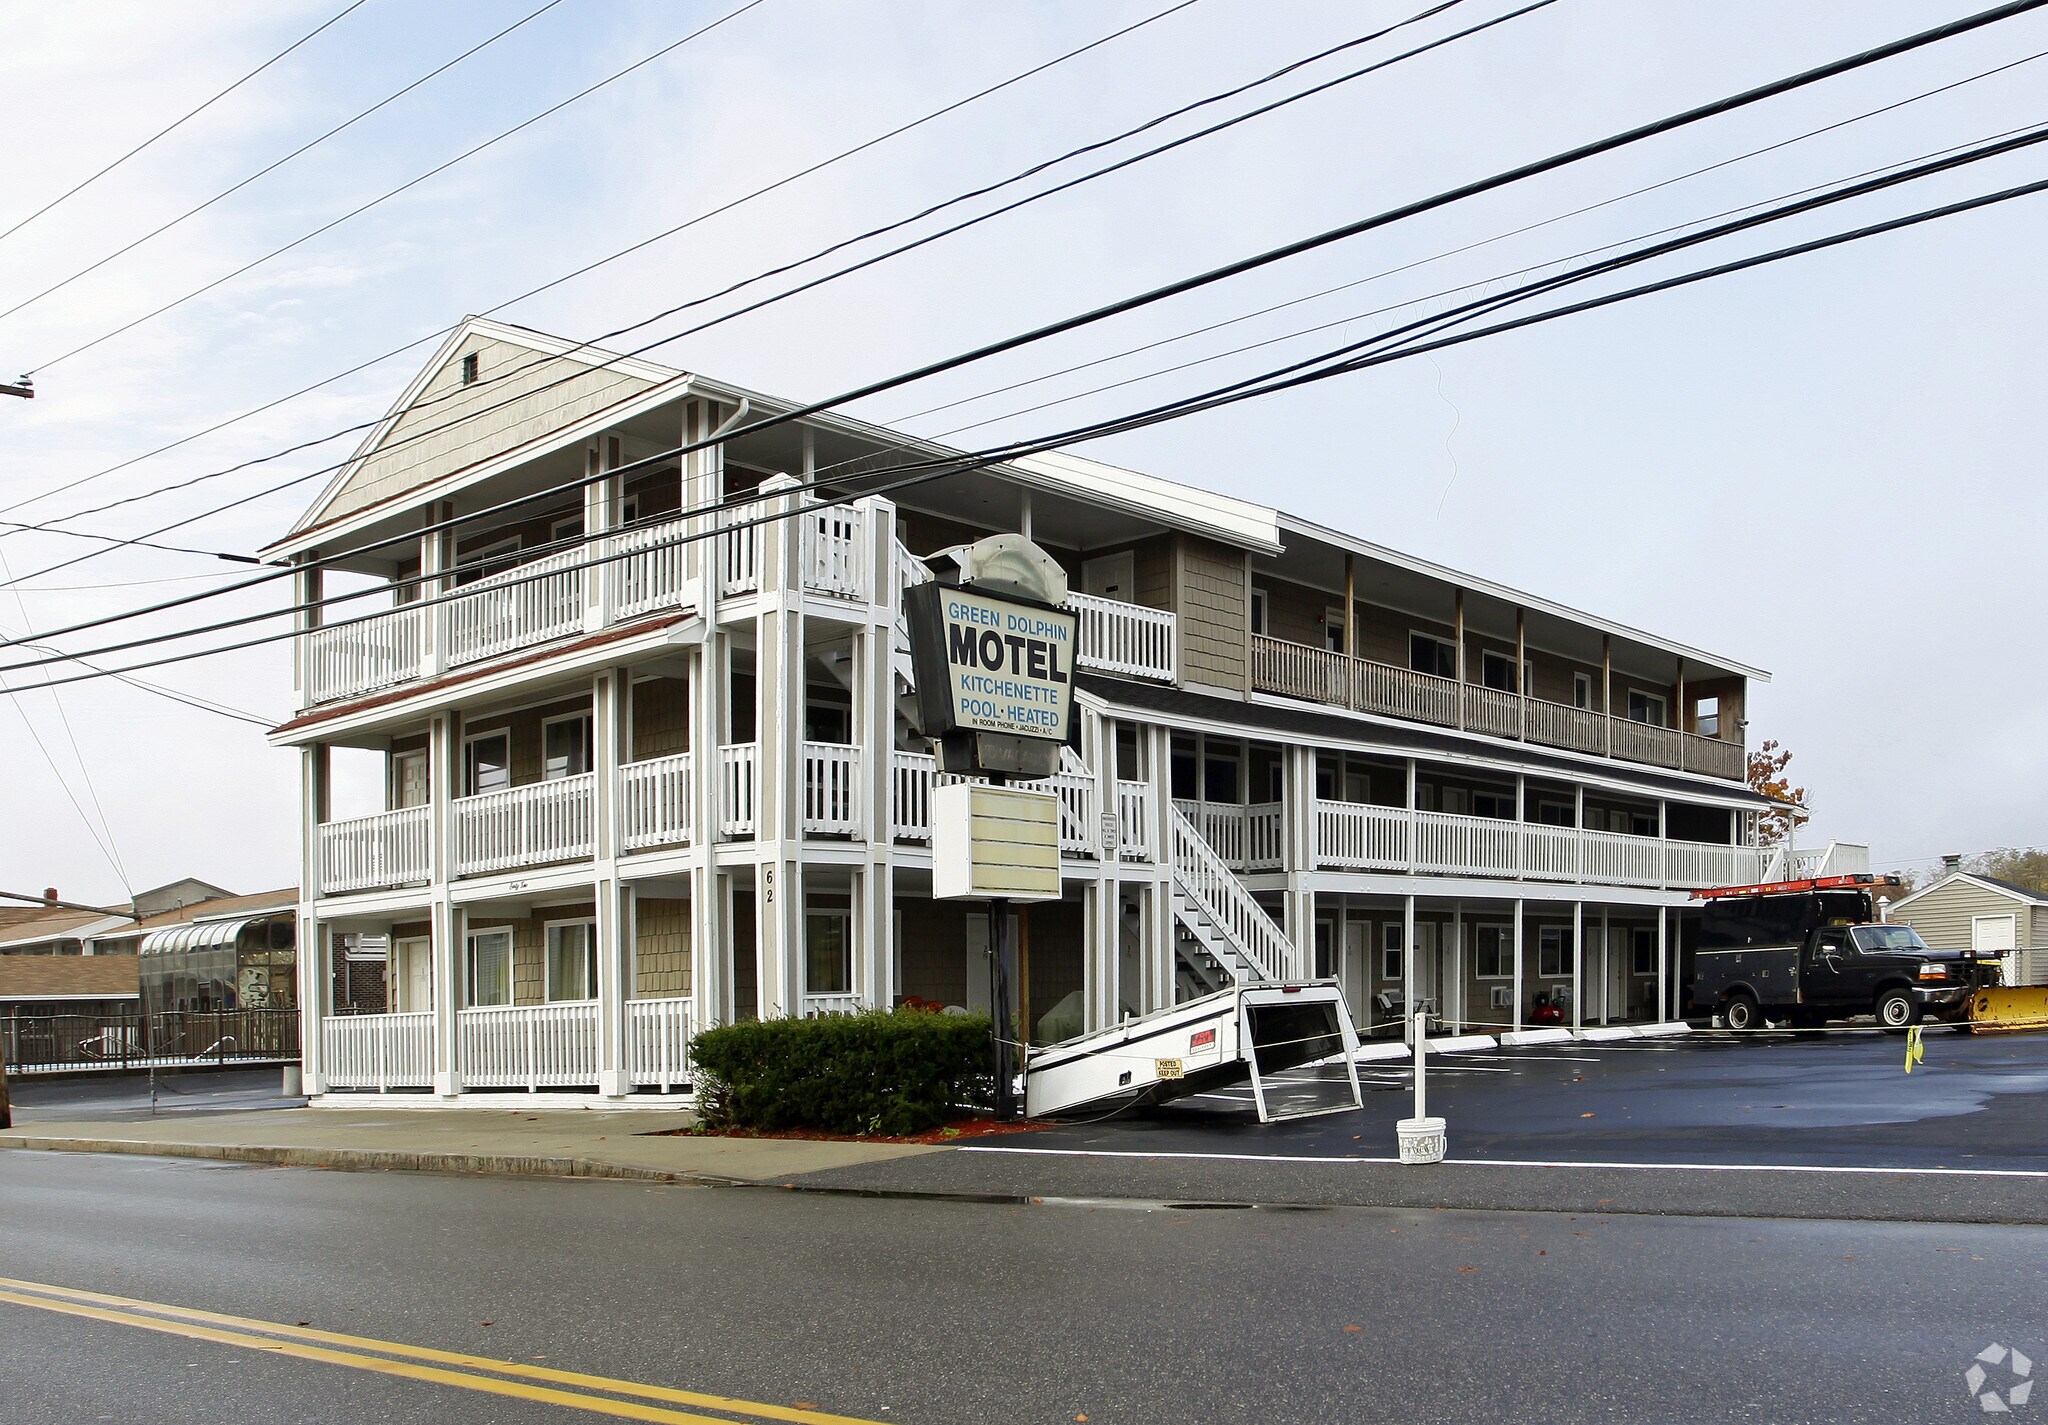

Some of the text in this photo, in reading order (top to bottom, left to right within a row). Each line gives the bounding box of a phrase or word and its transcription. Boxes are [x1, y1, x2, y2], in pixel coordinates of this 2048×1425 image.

[949, 602, 1067, 641] GREEN DOLPHIN
[949, 622, 1067, 684] MOTEL
[961, 674, 1058, 705] KITCHENETTE
[961, 698, 1059, 727] POOL HEATED
[980, 719, 996, 727] ROOM
[997, 721, 1015, 730] PHONE
[1019, 725, 1039, 733] JACUZZI
